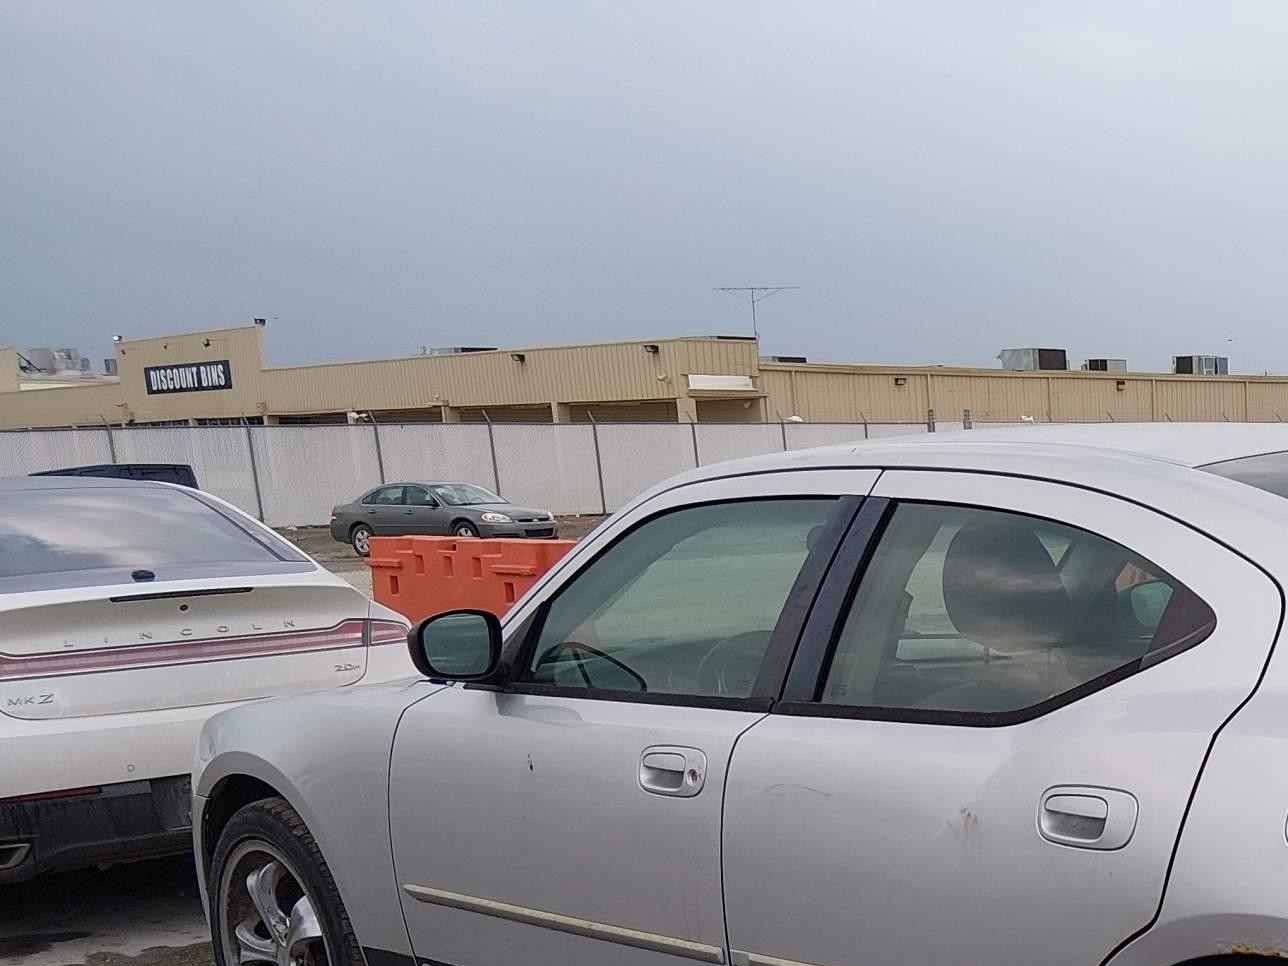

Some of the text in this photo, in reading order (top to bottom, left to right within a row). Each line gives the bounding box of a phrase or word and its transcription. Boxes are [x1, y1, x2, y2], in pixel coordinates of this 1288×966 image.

[149, 364, 226, 391] DISCOUNT BINS
[64, 618, 297, 648] LINCOLN
[7, 692, 55, 706] MKZ
